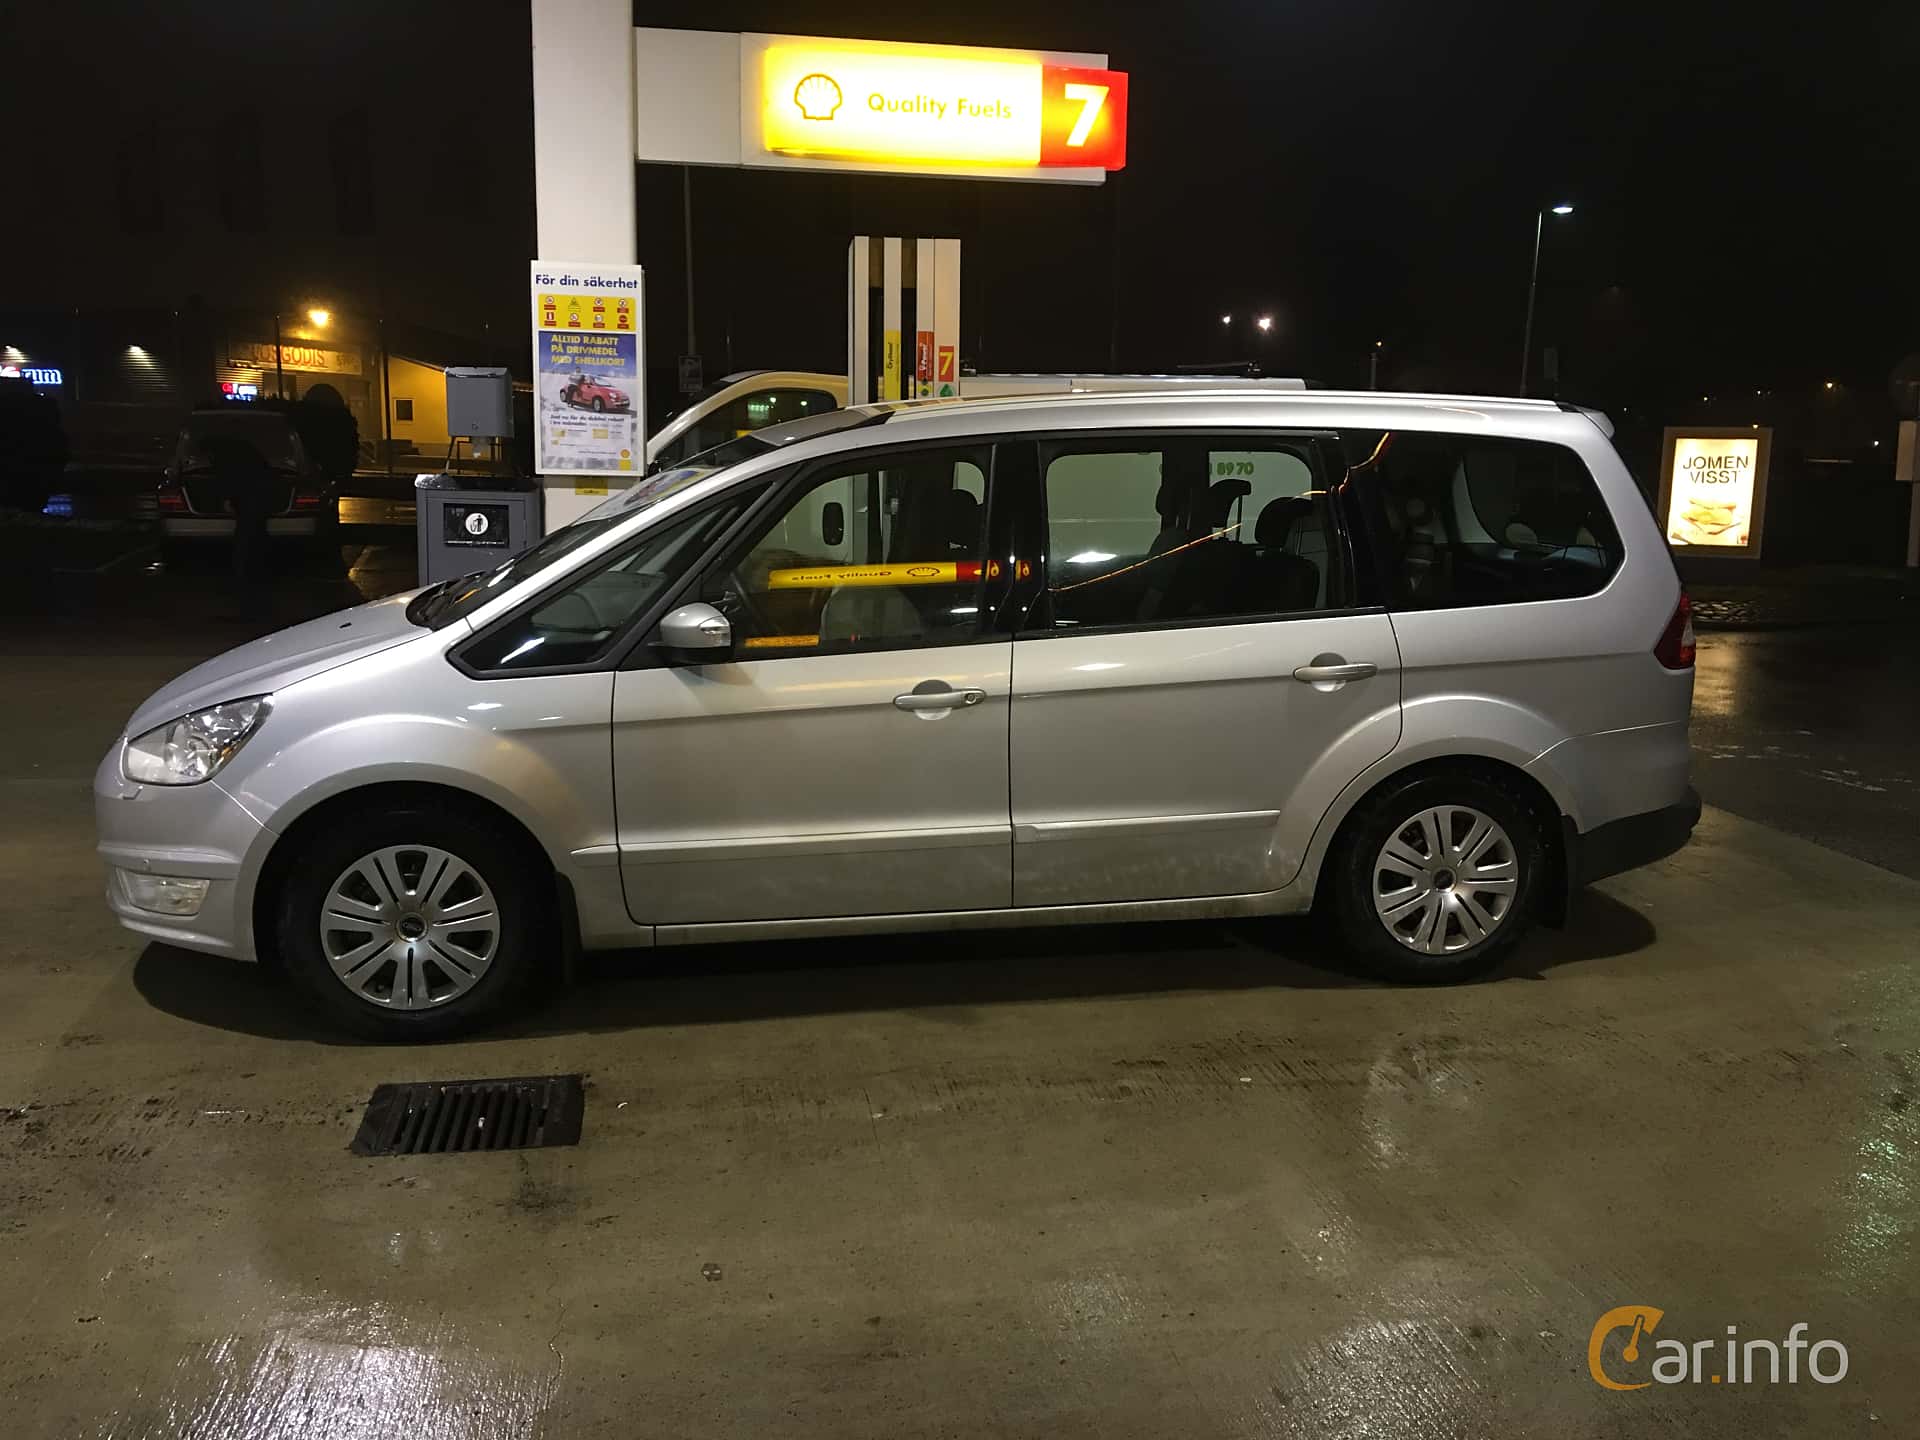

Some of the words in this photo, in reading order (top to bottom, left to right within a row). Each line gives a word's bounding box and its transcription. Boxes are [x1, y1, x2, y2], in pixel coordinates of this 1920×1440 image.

[867, 93, 947, 119] Quality
[957, 98, 1012, 119] Fuels
[1064, 82, 1110, 147] 7
[535, 274, 555, 285] För
[559, 274, 579, 286] din
[583, 276, 638, 289] säkerhet
[938, 352, 954, 376] 7
[1690, 470, 1738, 484] VISST
